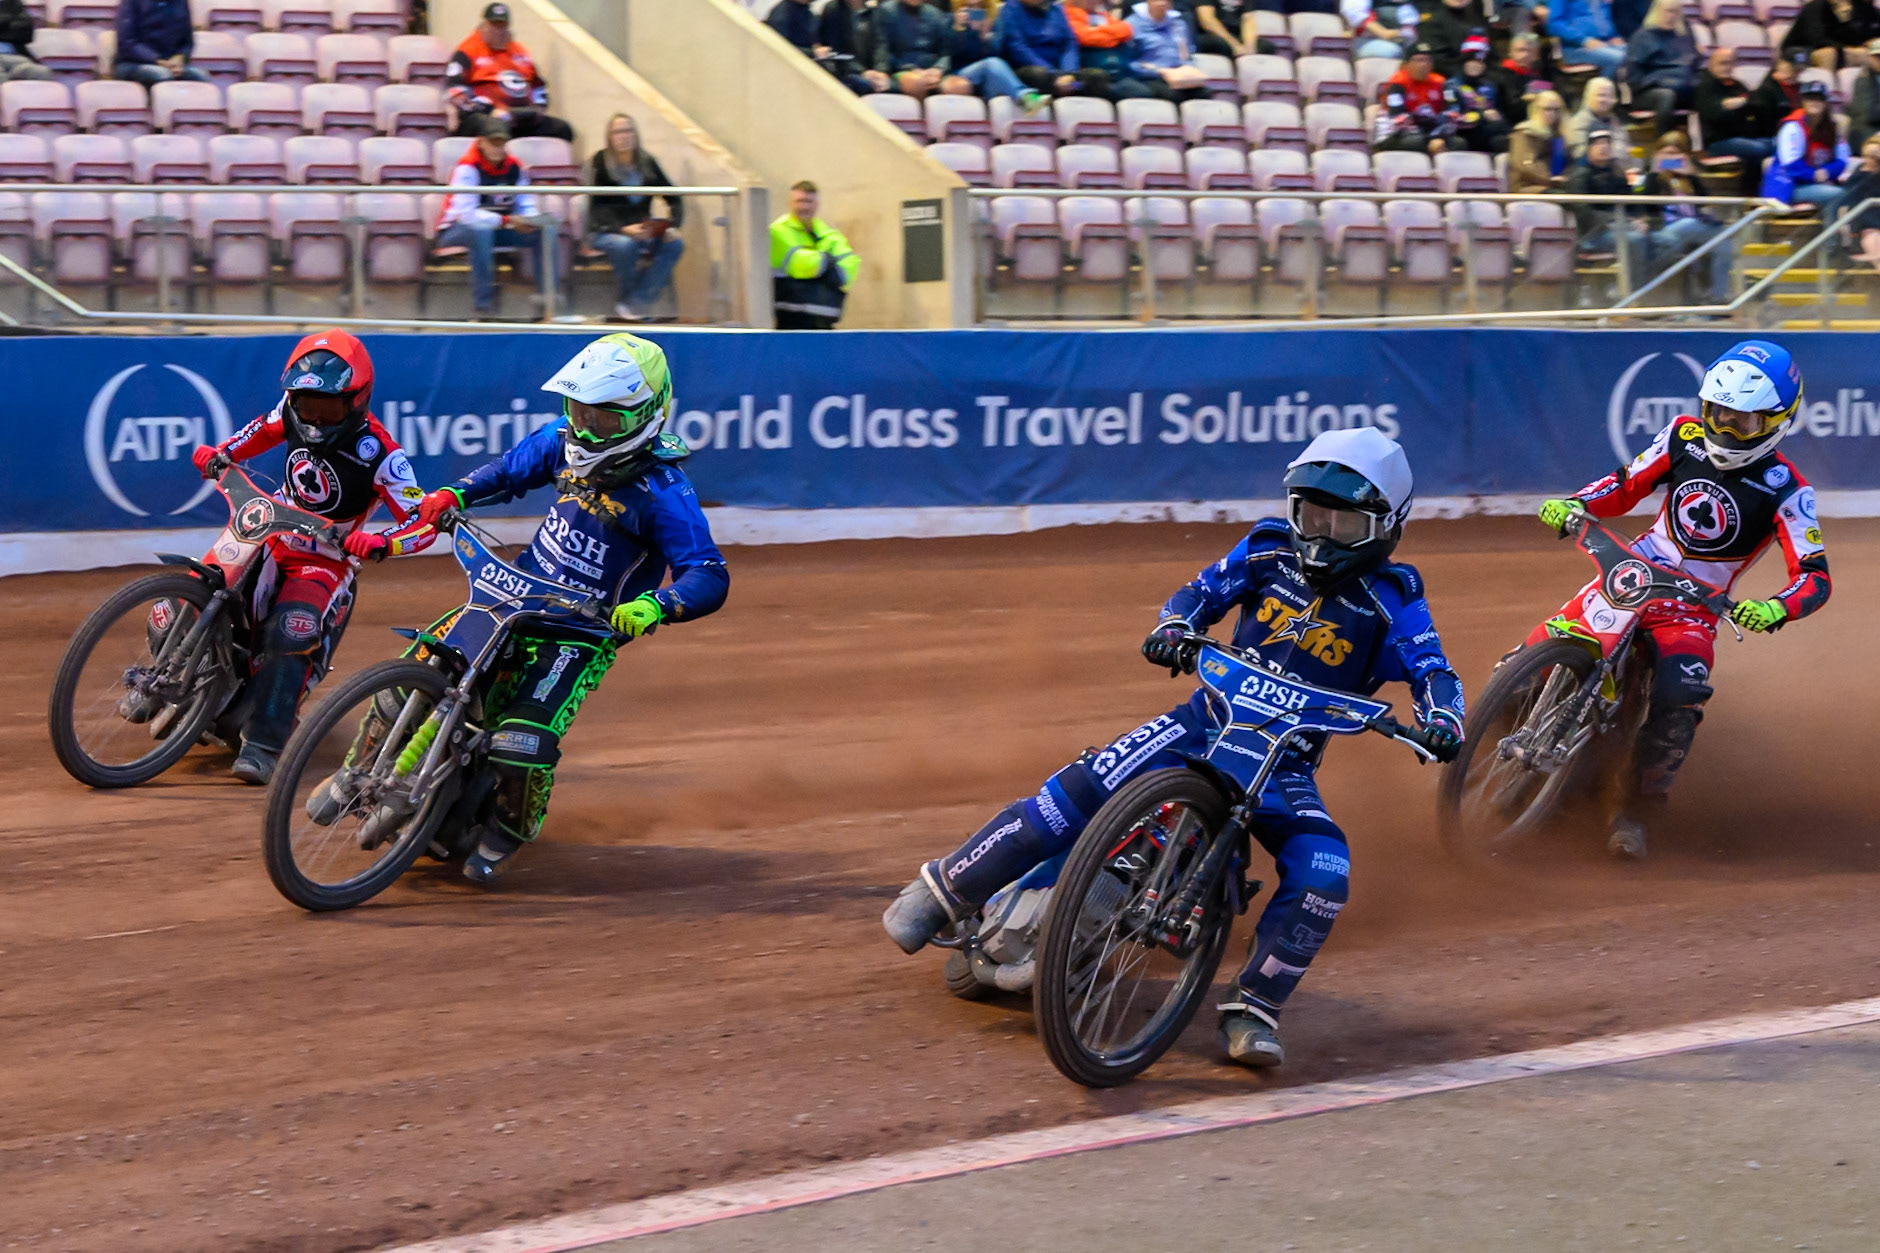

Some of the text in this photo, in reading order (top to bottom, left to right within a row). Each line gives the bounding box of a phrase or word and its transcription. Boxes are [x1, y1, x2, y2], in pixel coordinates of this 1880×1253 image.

[109, 416, 206, 462] ATPI
[382, 399, 560, 457] liverin
[810, 396, 957, 450] Class
[976, 392, 1143, 448] Travel
[1159, 391, 1400, 445] Solutions
[291, 452, 308, 464] BELLE
[1678, 483, 1704, 498] BELLE
[1707, 485, 1726, 501] VUE
[1723, 503, 1737, 526] ACES
[554, 516, 610, 566] PSH
[492, 567, 533, 598] PSH
[287, 617, 314, 630] STS
[1257, 680, 1310, 710] PSH
[1111, 714, 1176, 758] PSH
[1107, 739, 1165, 787] ENVIRONMENTAL
[947, 817, 1024, 880] POLCOPPER
